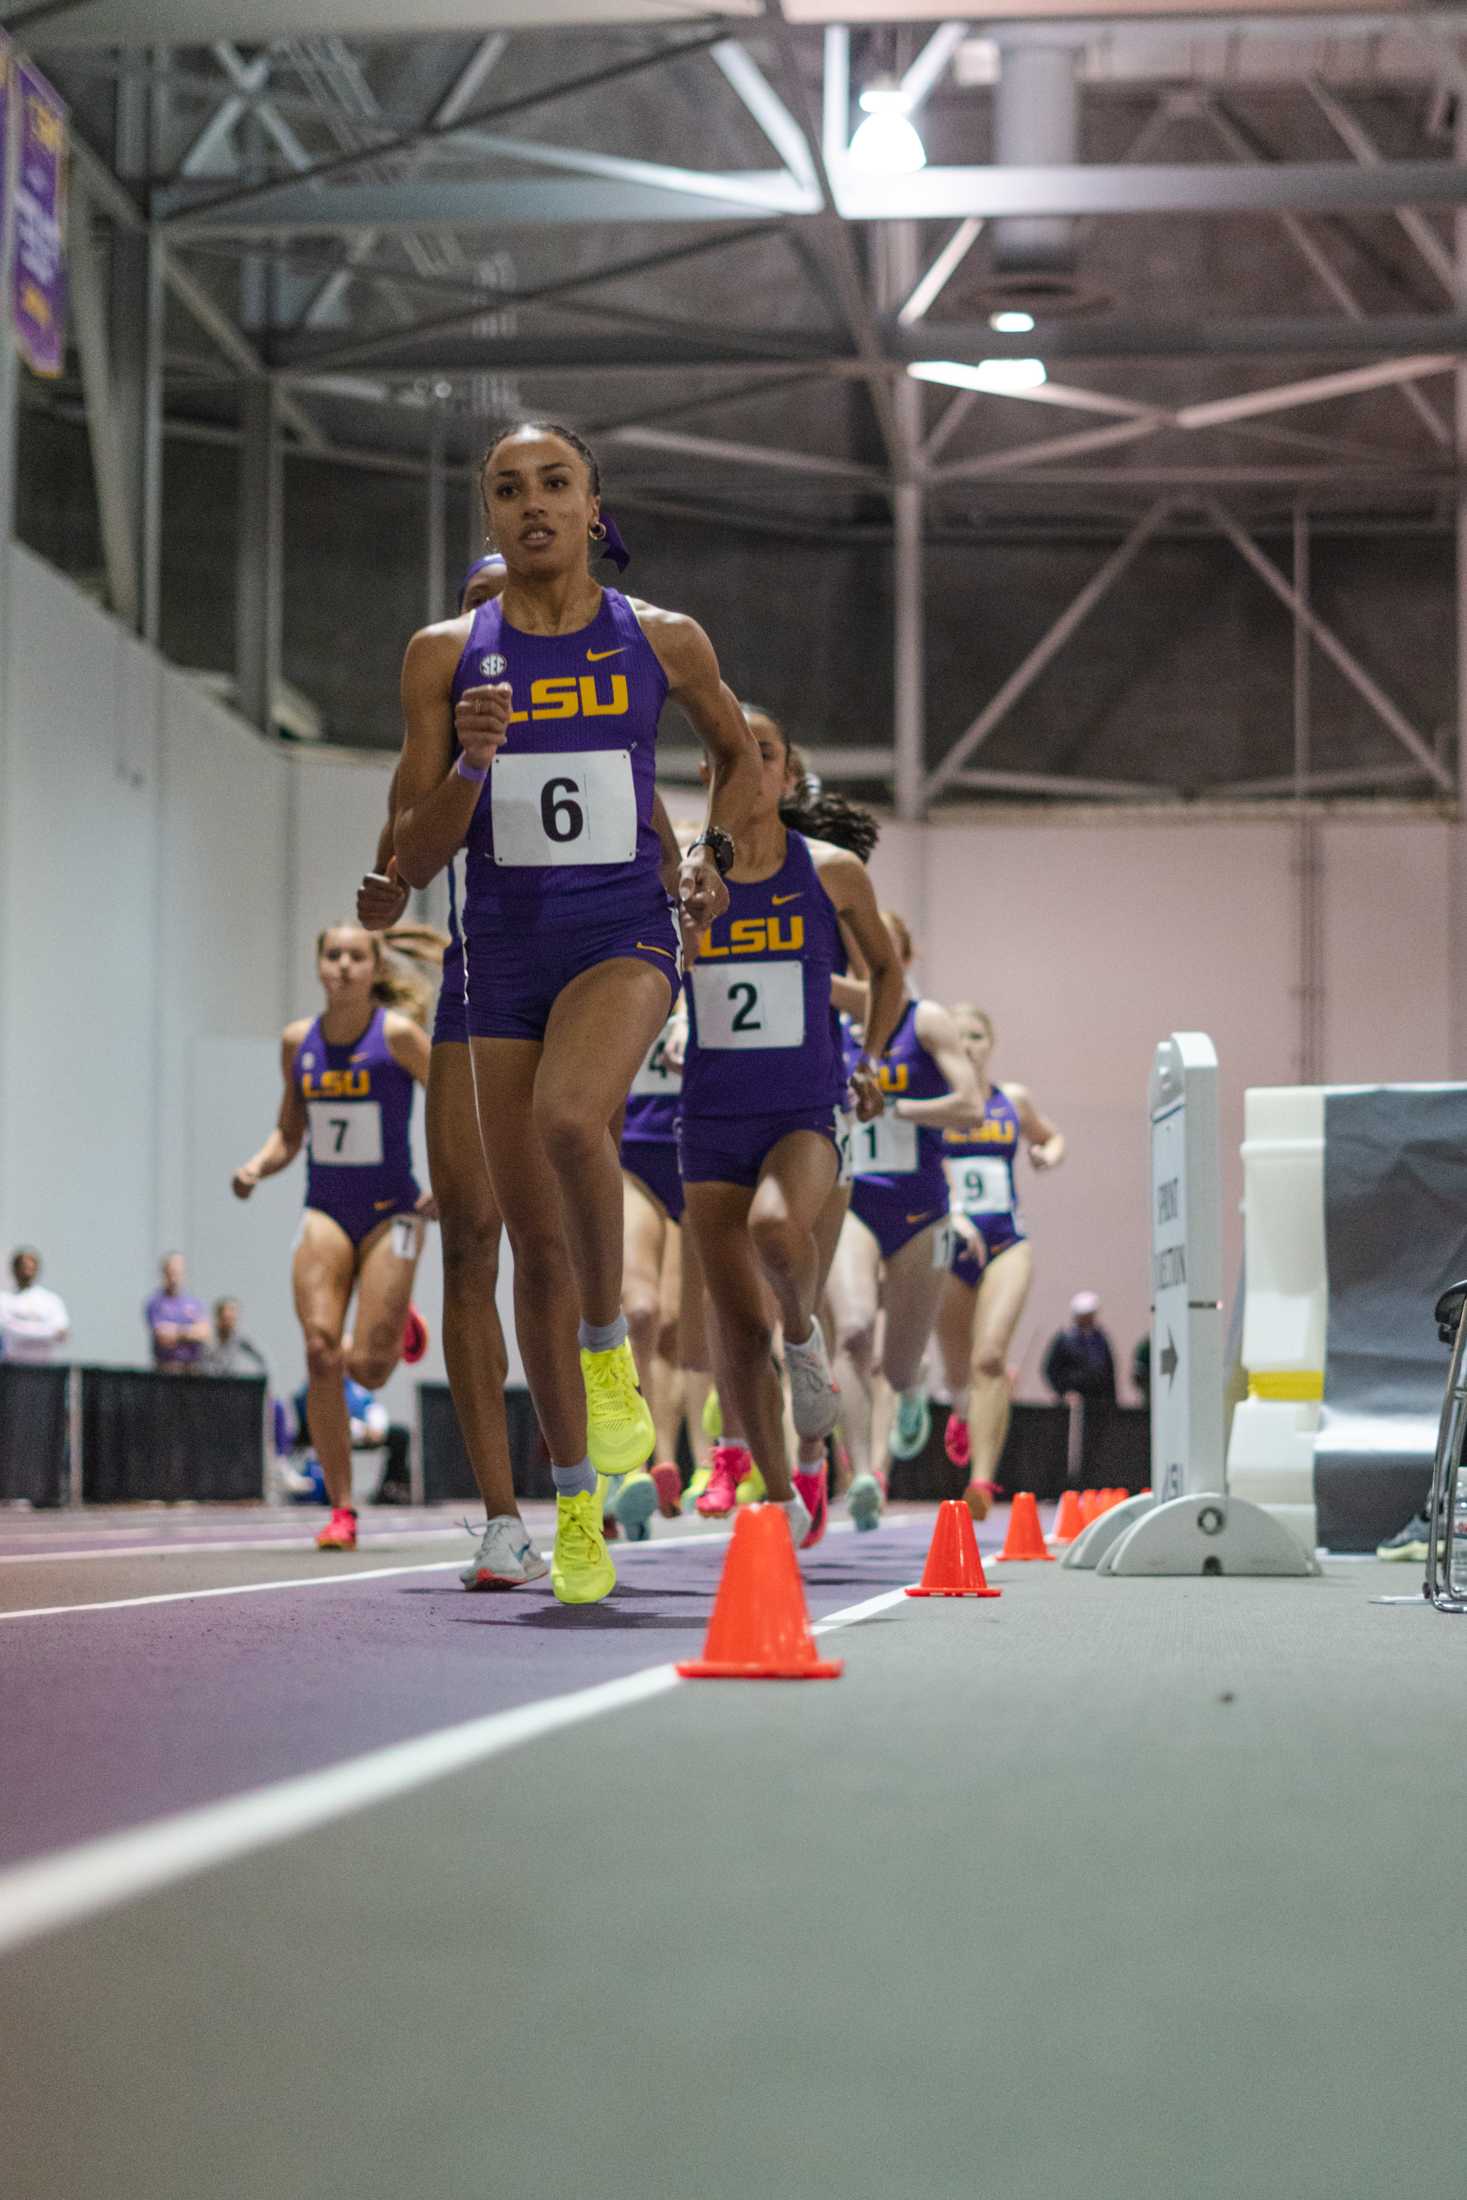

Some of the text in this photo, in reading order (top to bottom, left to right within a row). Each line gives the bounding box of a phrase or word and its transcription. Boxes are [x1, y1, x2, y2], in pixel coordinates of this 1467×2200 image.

[481, 655, 506, 676] SEC
[509, 675, 629, 724] SU
[540, 777, 584, 843] 6
[698, 915, 804, 958] LSU
[727, 982, 761, 1032] 2
[302, 1069, 370, 1097] LSU
[329, 1119, 348, 1152] 7
[862, 1124, 877, 1160] 1
[964, 1171, 984, 1202] 9
